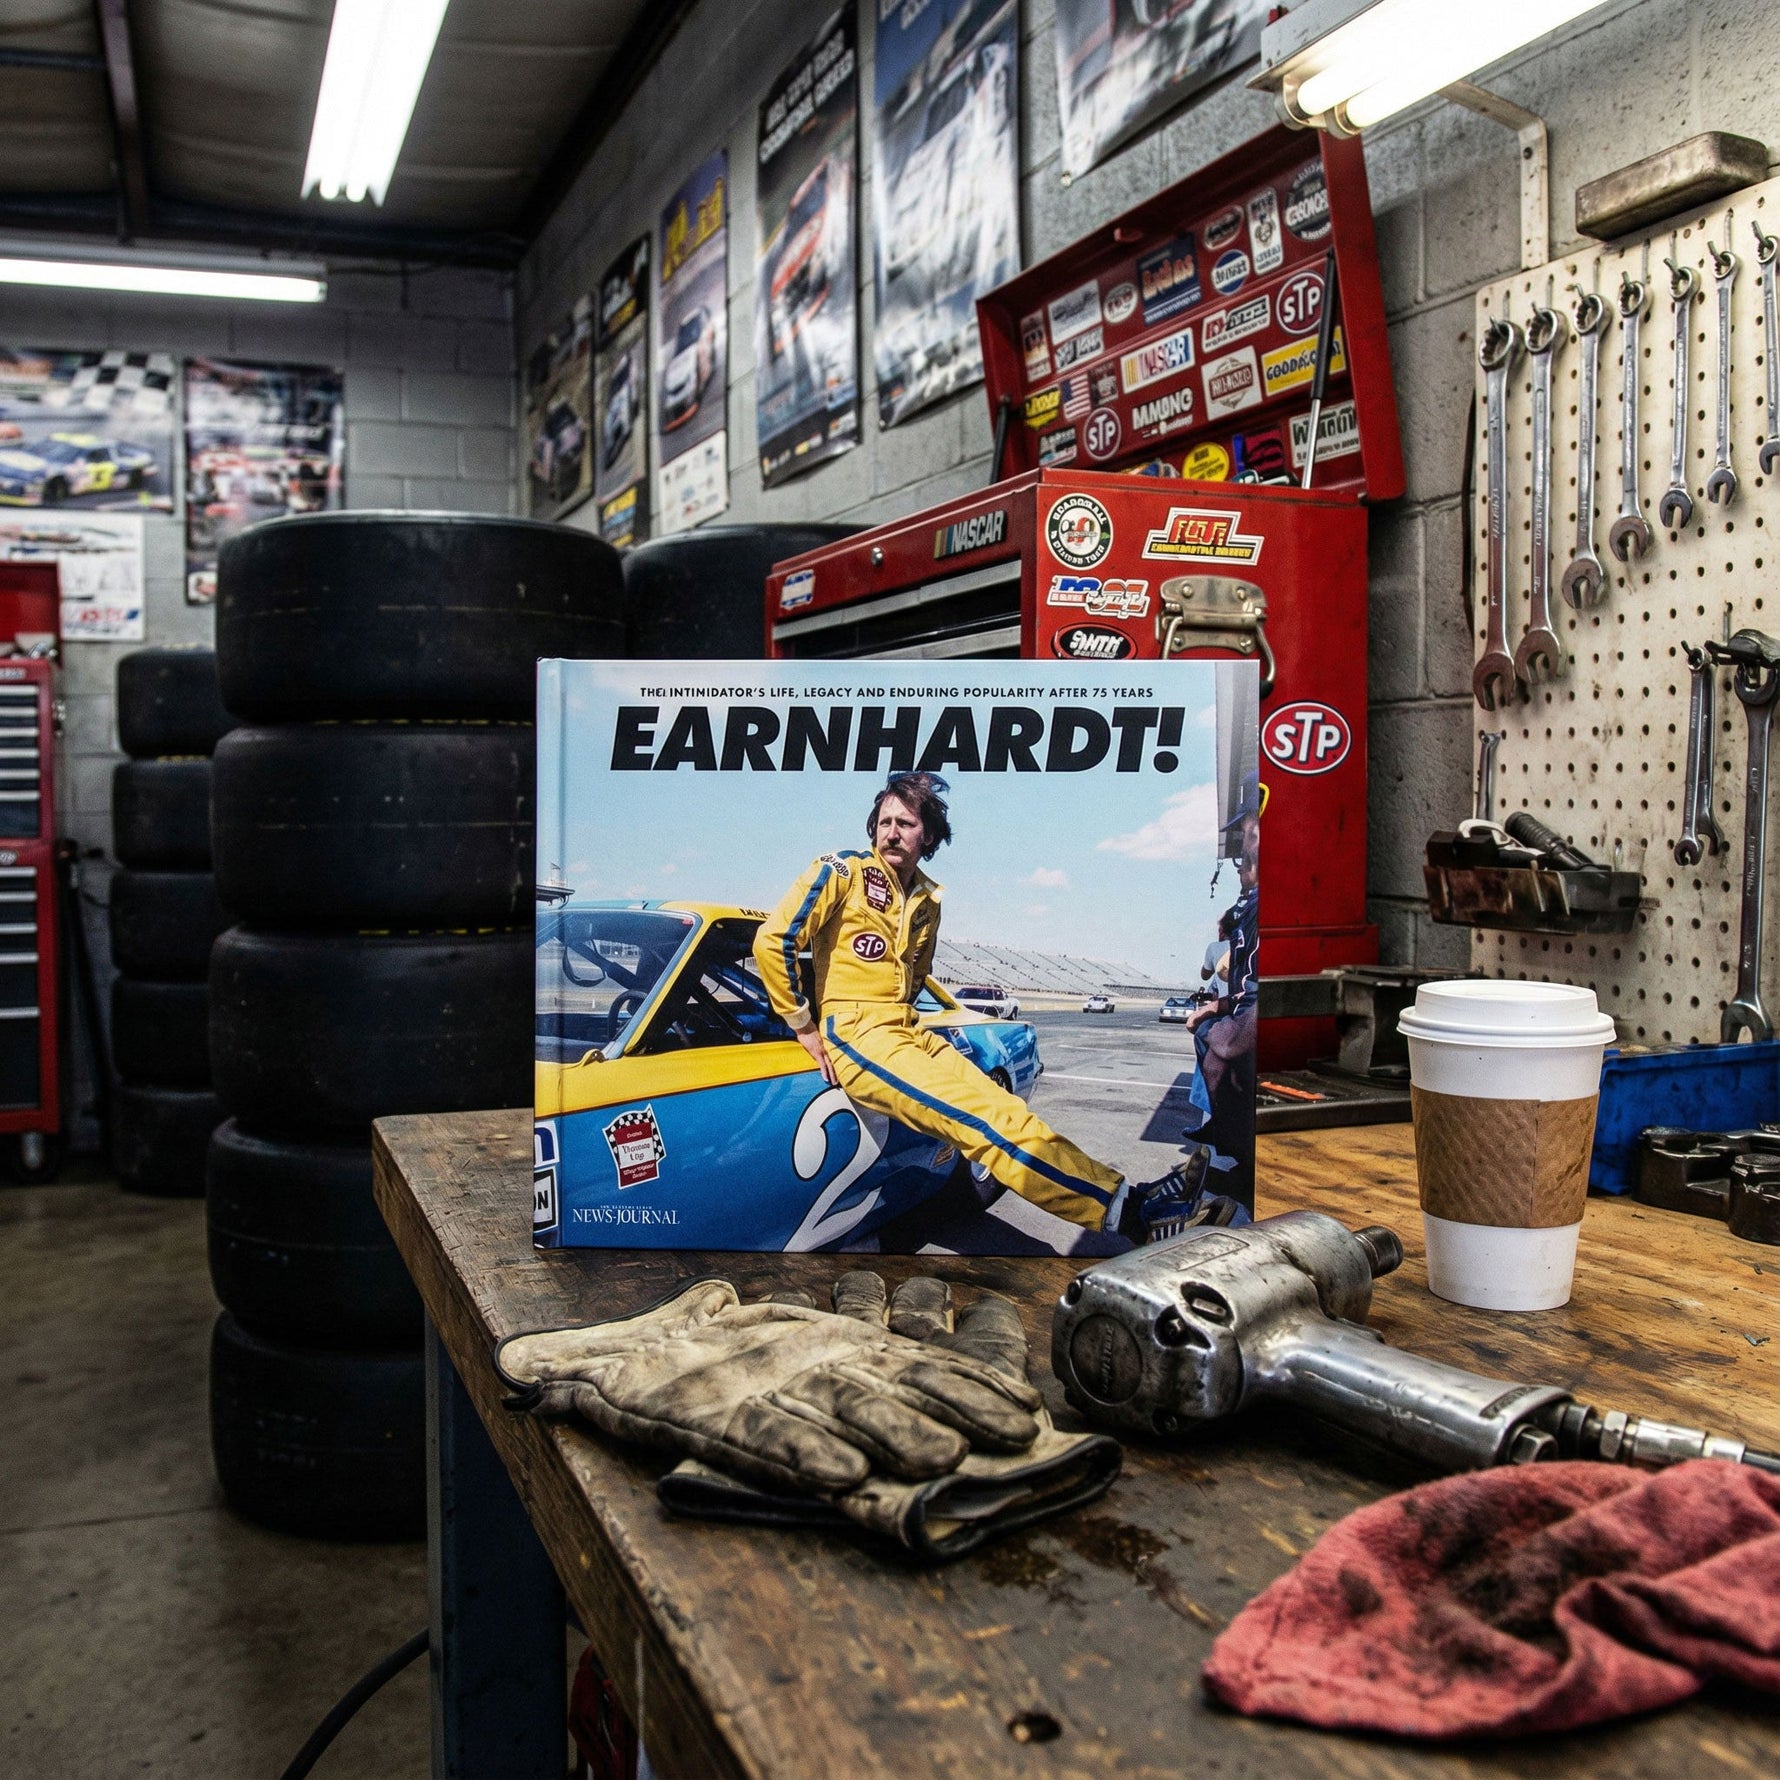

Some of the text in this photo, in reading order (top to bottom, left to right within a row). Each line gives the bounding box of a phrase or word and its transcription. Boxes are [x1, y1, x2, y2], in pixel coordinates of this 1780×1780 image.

[1283, 279, 1321, 324] STP
[1088, 413, 1116, 451] STP
[951, 510, 1006, 554] NASCAR
[669, 687, 766, 698] INTIMIDATOR'S
[770, 687, 800, 699] LIFE,
[803, 687, 853, 698] LEGACY
[856, 687, 885, 698] AND
[889, 687, 960, 698] ENDURING
[963, 687, 1045, 698] POPULARITY
[1049, 687, 1089, 698] AFTER
[1091, 687, 1108, 698] 75
[1112, 687, 1154, 698] YEARS
[611, 706, 1186, 774] EARNHARDT!
[1271, 711, 1342, 763] STP
[855, 935, 885, 956] STP
[572, 1208, 681, 1226] NEWS-JOURNAL
